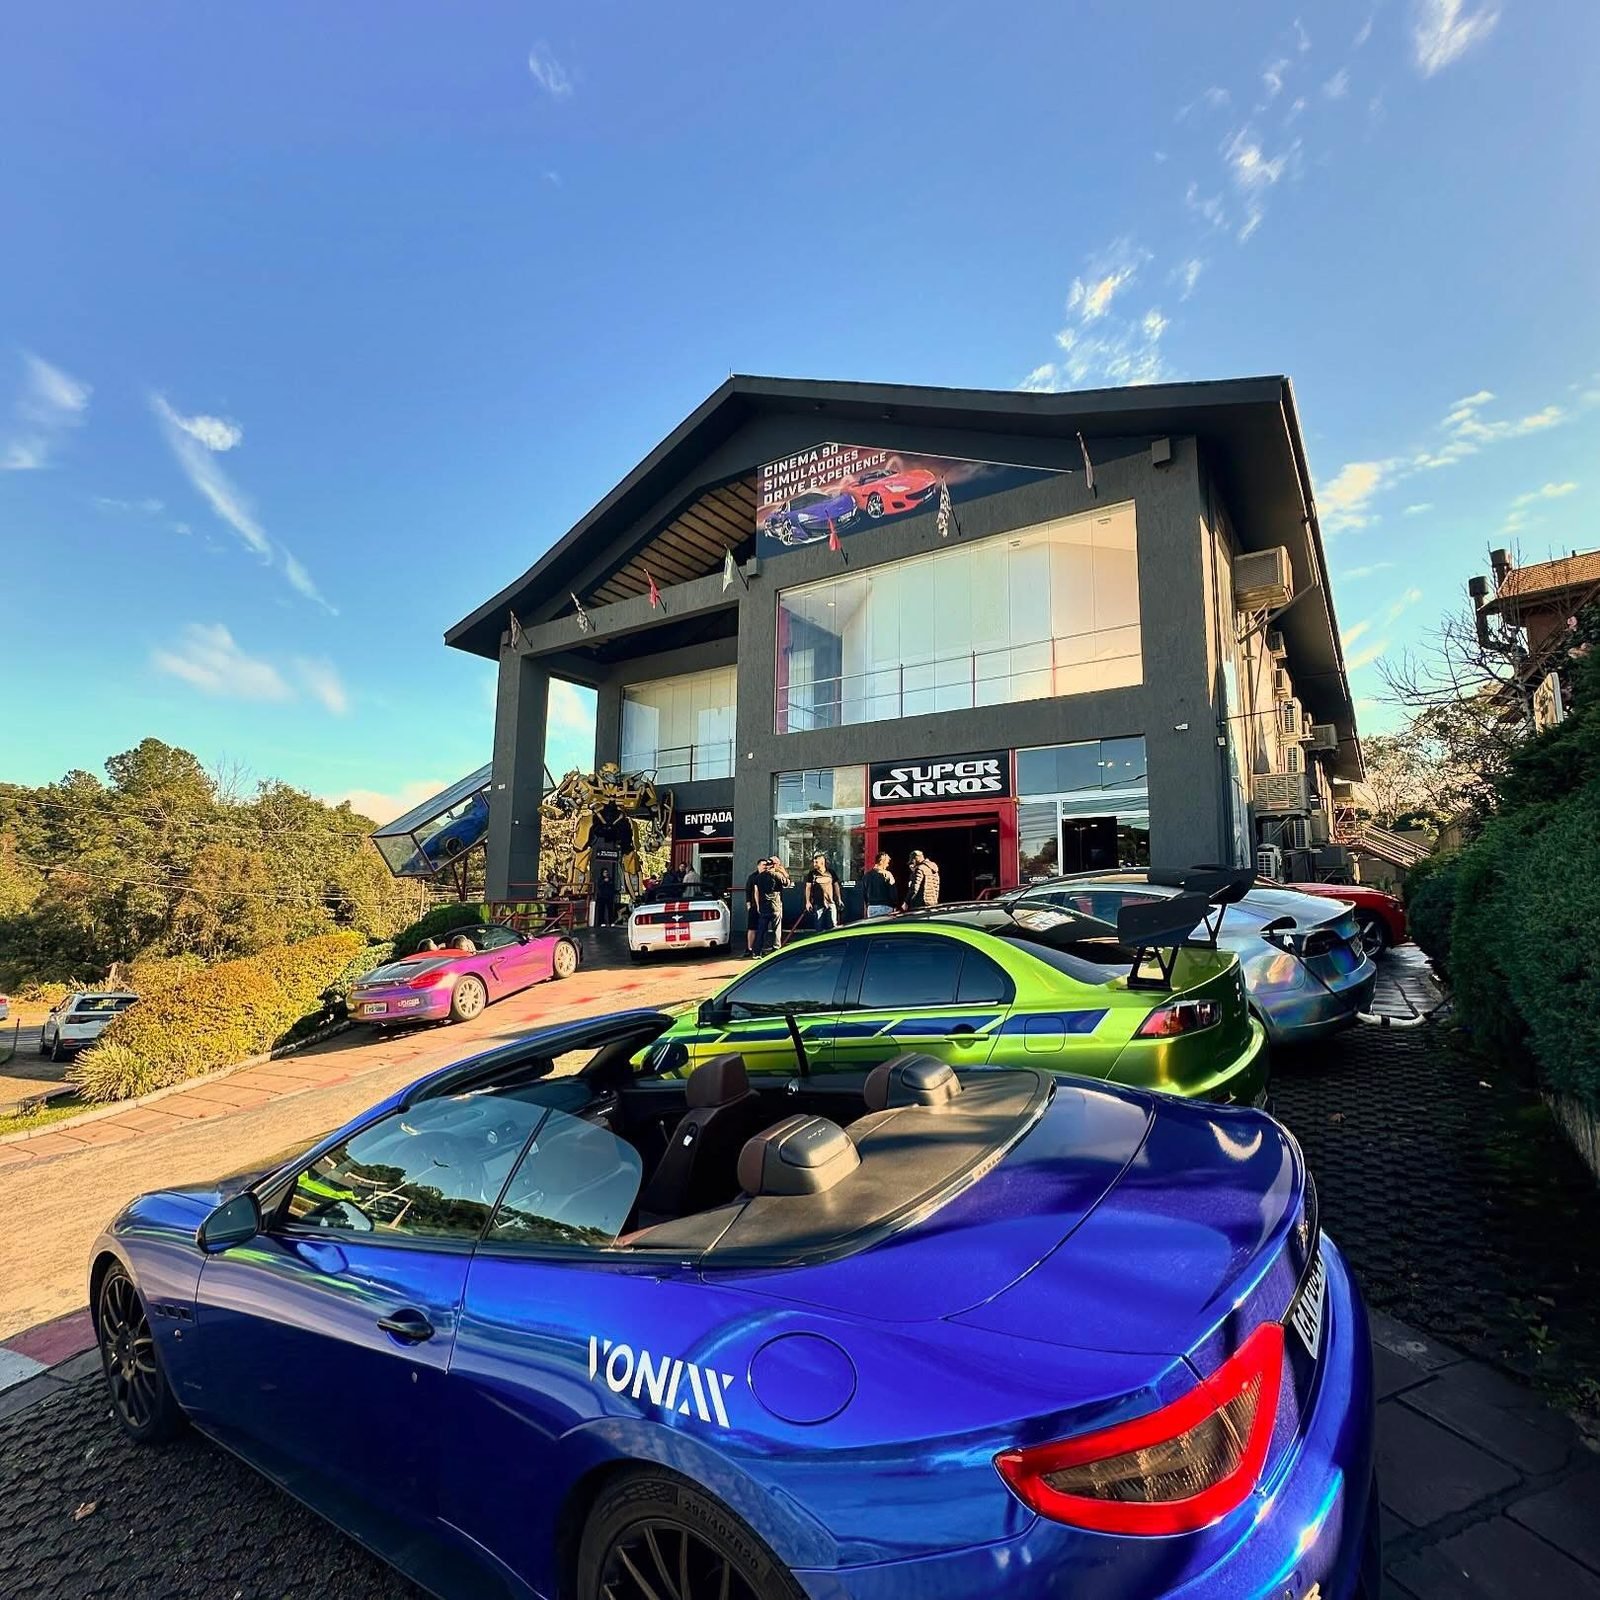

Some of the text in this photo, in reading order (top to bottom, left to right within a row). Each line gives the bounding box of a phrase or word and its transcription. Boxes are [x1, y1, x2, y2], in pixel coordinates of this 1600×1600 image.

[764, 452, 819, 477] CINEMA
[764, 450, 859, 491] SIMULADORES
[764, 452, 887, 505] DRIVE EXPERIENCE
[885, 759, 1001, 783] SUPER
[872, 776, 1003, 800] CARROS
[684, 811, 733, 825] ENTRADA
